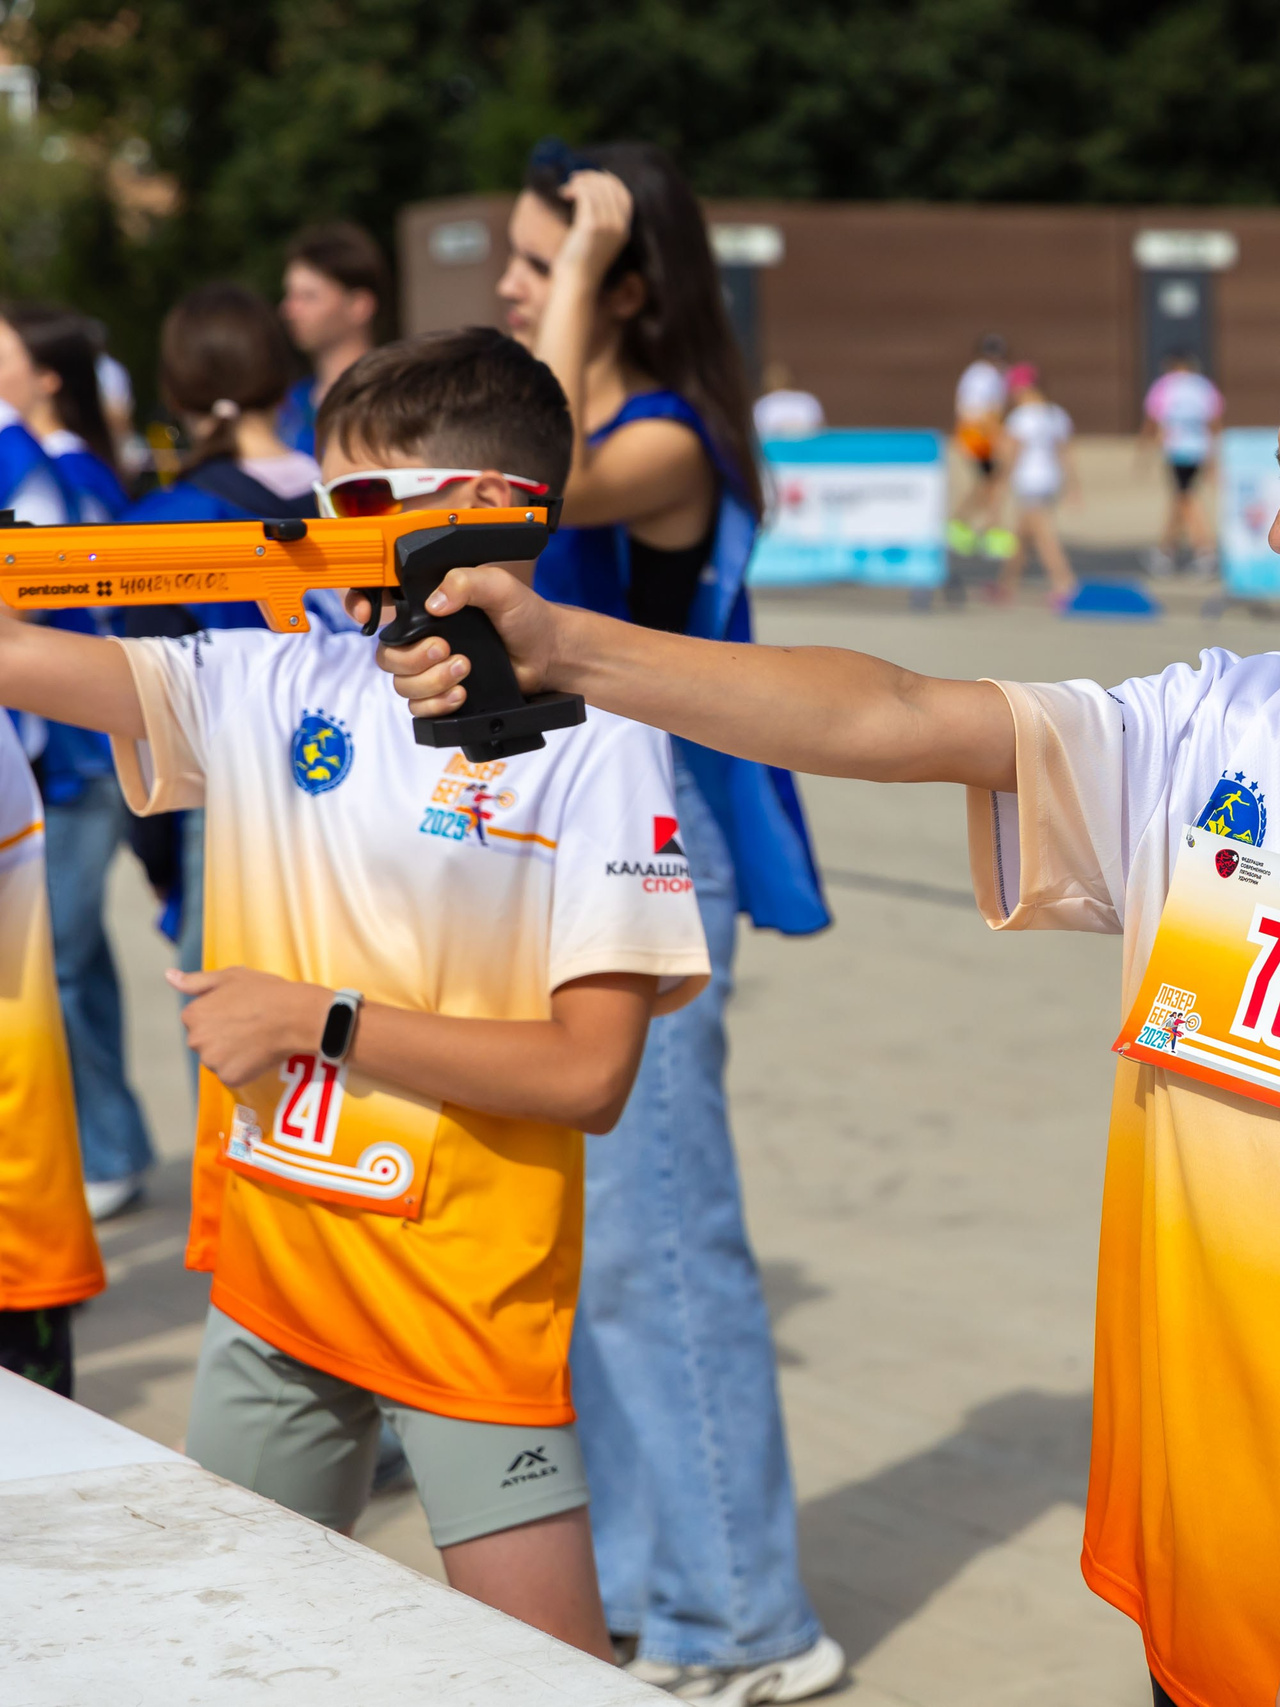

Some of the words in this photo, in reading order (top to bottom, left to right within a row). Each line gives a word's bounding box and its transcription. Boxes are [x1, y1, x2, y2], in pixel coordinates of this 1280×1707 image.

[17, 583, 90, 598] pentashot
[1157, 985, 1195, 1012] ЛАЗЕР
[1137, 1026, 1169, 1050] 2025
[281, 1053, 338, 1144] 21
